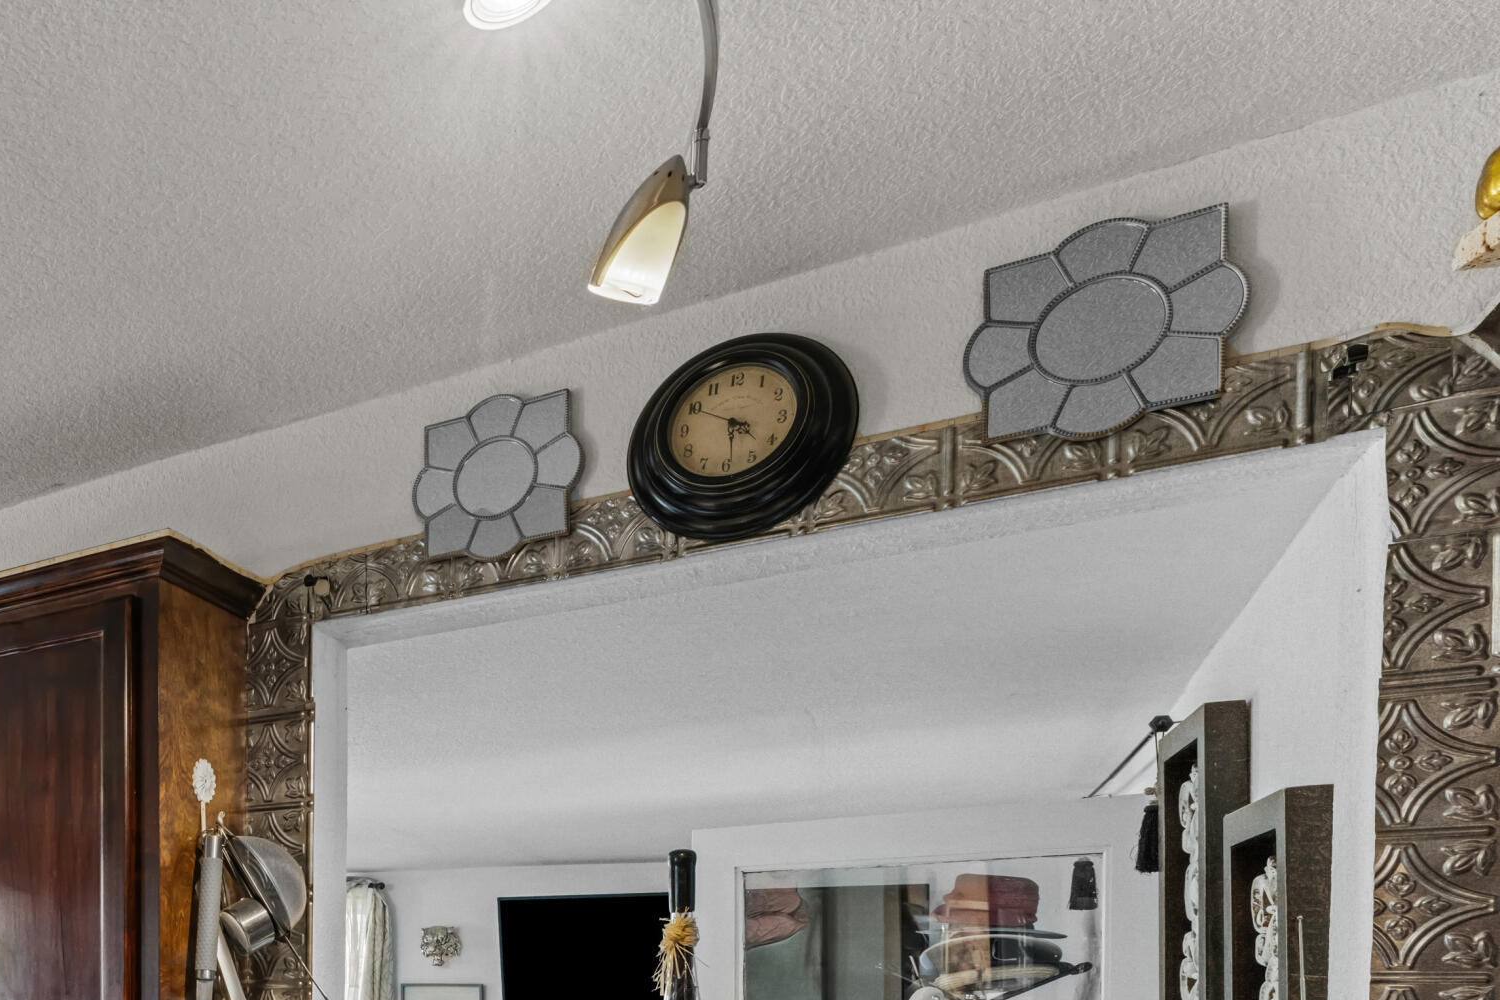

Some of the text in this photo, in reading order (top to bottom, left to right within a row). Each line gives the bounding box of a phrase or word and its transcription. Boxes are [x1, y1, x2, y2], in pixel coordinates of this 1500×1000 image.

[730, 371, 745, 388] 12
[758, 374, 765, 388] 1
[707, 382, 720, 396] 11
[774, 387, 784, 401] 2
[688, 400, 703, 415] 10
[776, 408, 788, 424] 3
[679, 424, 690, 439] 9
[766, 432, 778, 446] 4
[682, 443, 694, 458] 8
[746, 450, 757, 464] 5
[699, 457, 709, 472] 7
[720, 458, 732, 473] 6
